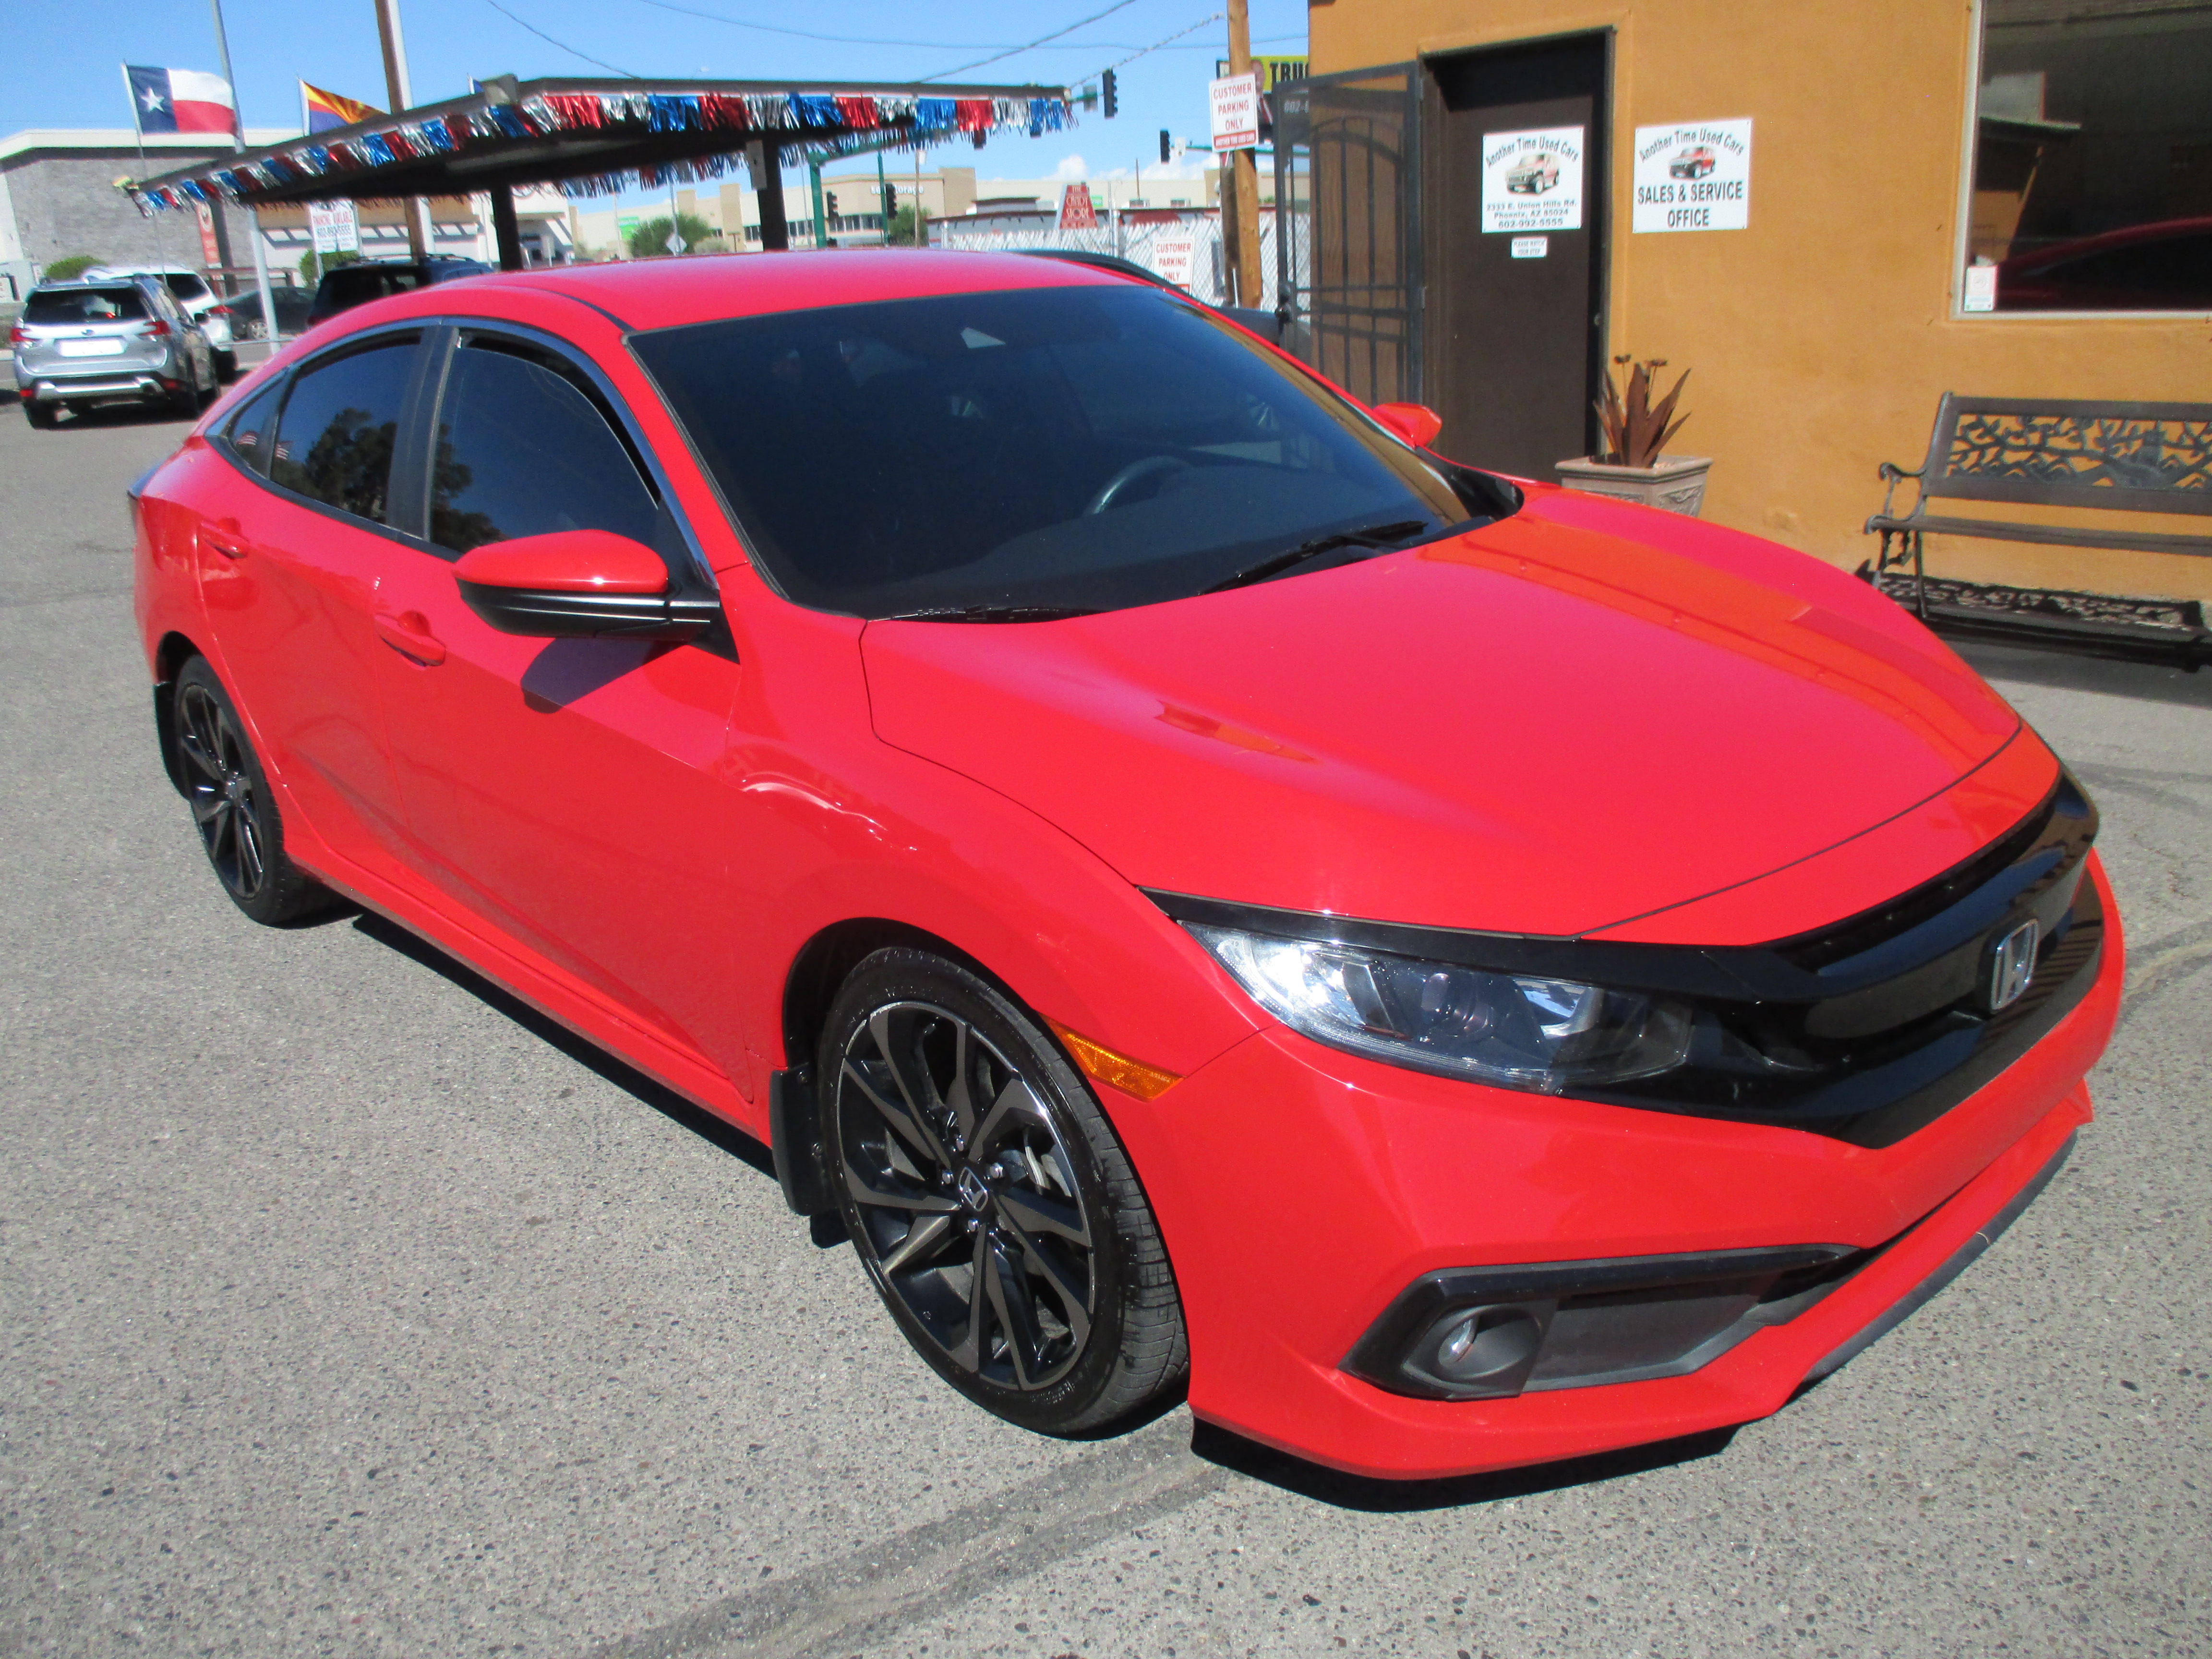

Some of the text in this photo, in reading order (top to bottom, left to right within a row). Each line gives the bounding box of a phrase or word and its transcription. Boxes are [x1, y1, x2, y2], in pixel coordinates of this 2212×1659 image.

[1270, 61, 1309, 83] TRU
[1214, 83, 1252, 100] CUSTOMER
[1218, 100, 1249, 116] PARKING
[1225, 117, 1243, 131] ONLY
[1486, 136, 1579, 168] Another Time Used Cars
[1639, 128, 1744, 163] Another Time Used Cars
[1638, 180, 1743, 204] SALES & SERVICE
[1066, 196, 1088, 208] CANDY
[1066, 207, 1089, 219] STORE
[1667, 208, 1710, 228] OFFICE
[1498, 218, 1563, 228] 602-992-5555
[1156, 243, 1191, 253] CUSTOMER
[1159, 258, 1187, 267] PARKING
[1164, 272, 1181, 282] ONLY
